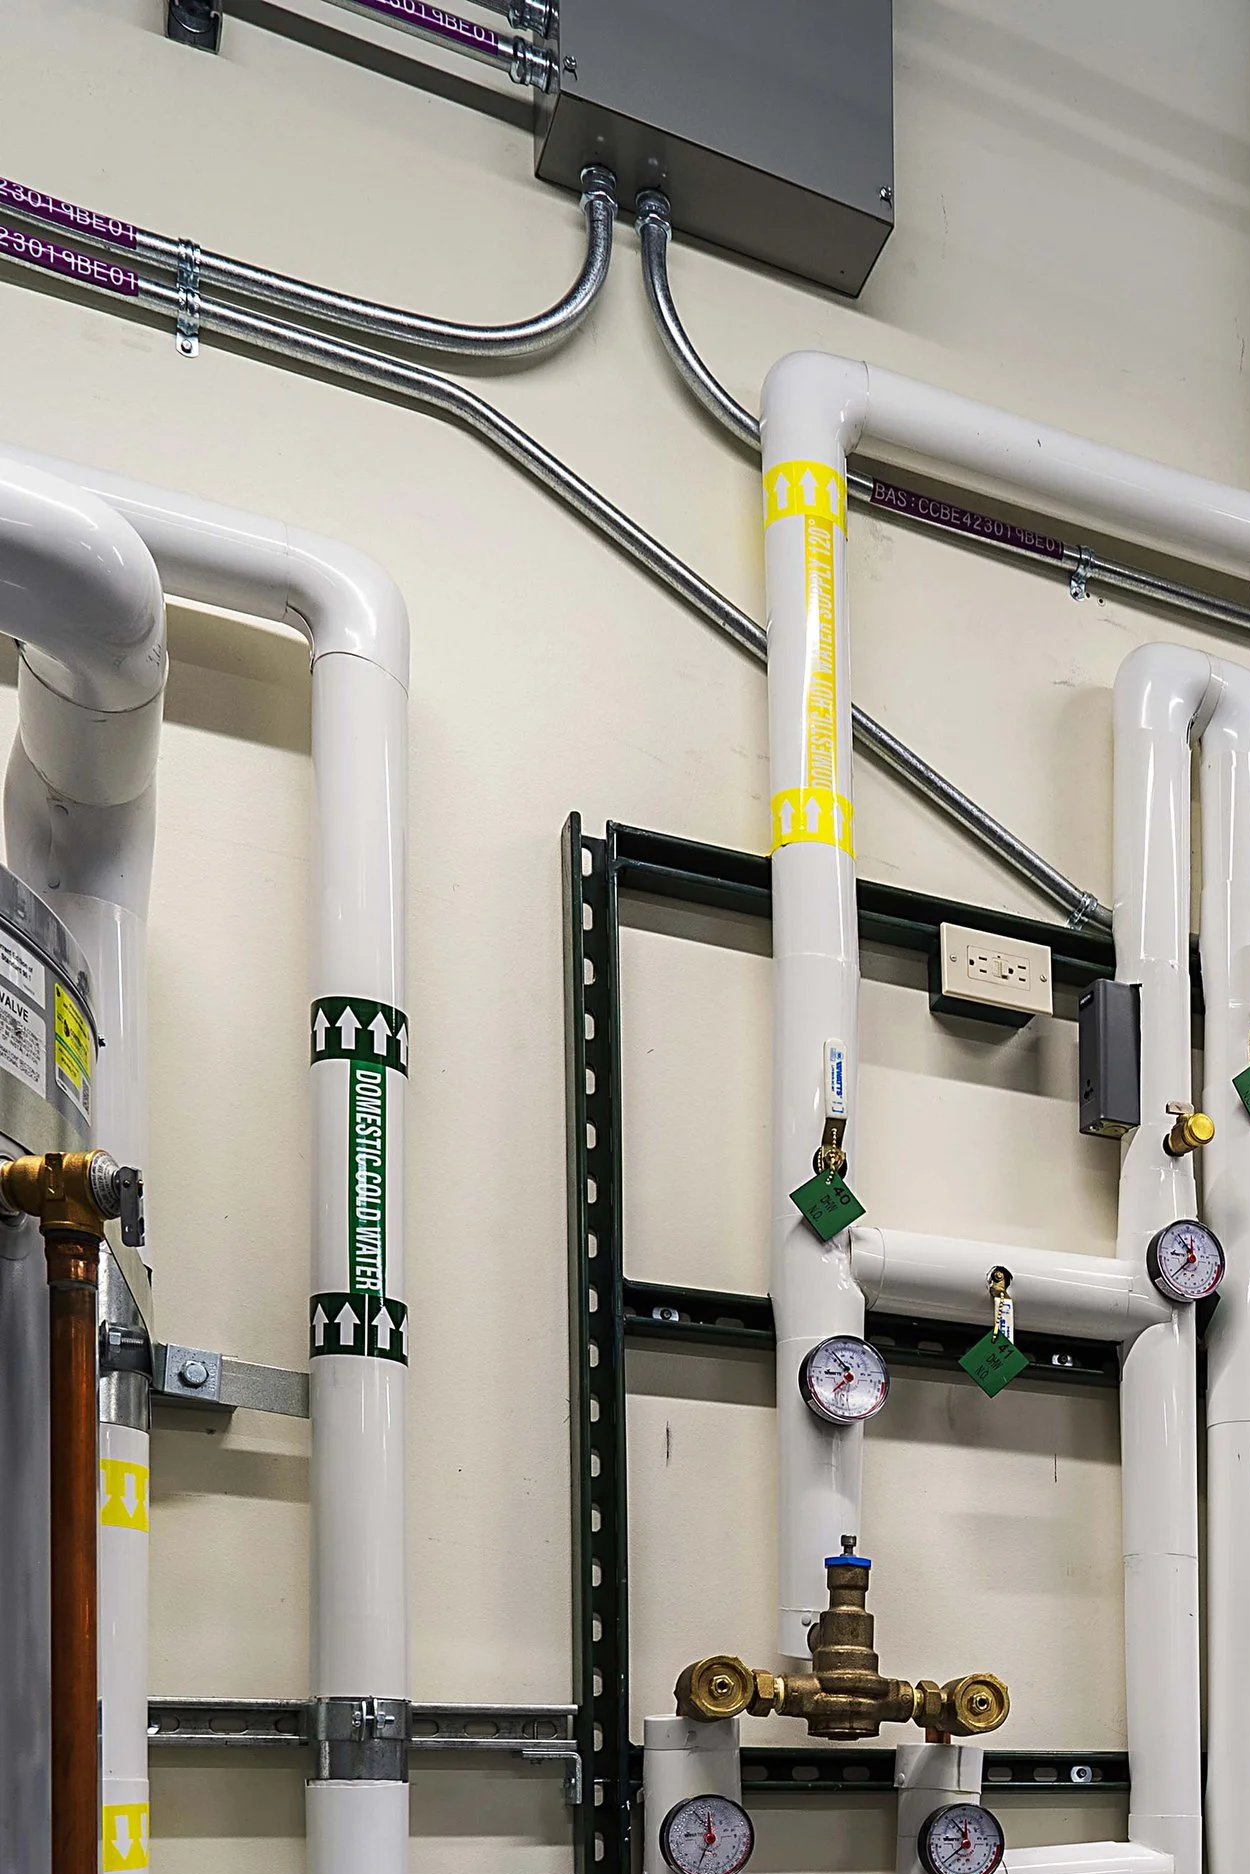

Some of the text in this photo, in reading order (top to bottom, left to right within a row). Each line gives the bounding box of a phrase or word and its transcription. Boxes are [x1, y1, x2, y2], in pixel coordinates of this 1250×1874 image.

[809, 676, 833, 708] HOT
[809, 710, 834, 790] DOMESTIC
[355, 1069, 383, 1297] DOMESTIC COLD WATER
[833, 1186, 851, 1206] 40
[999, 1344, 1014, 1359] 41
